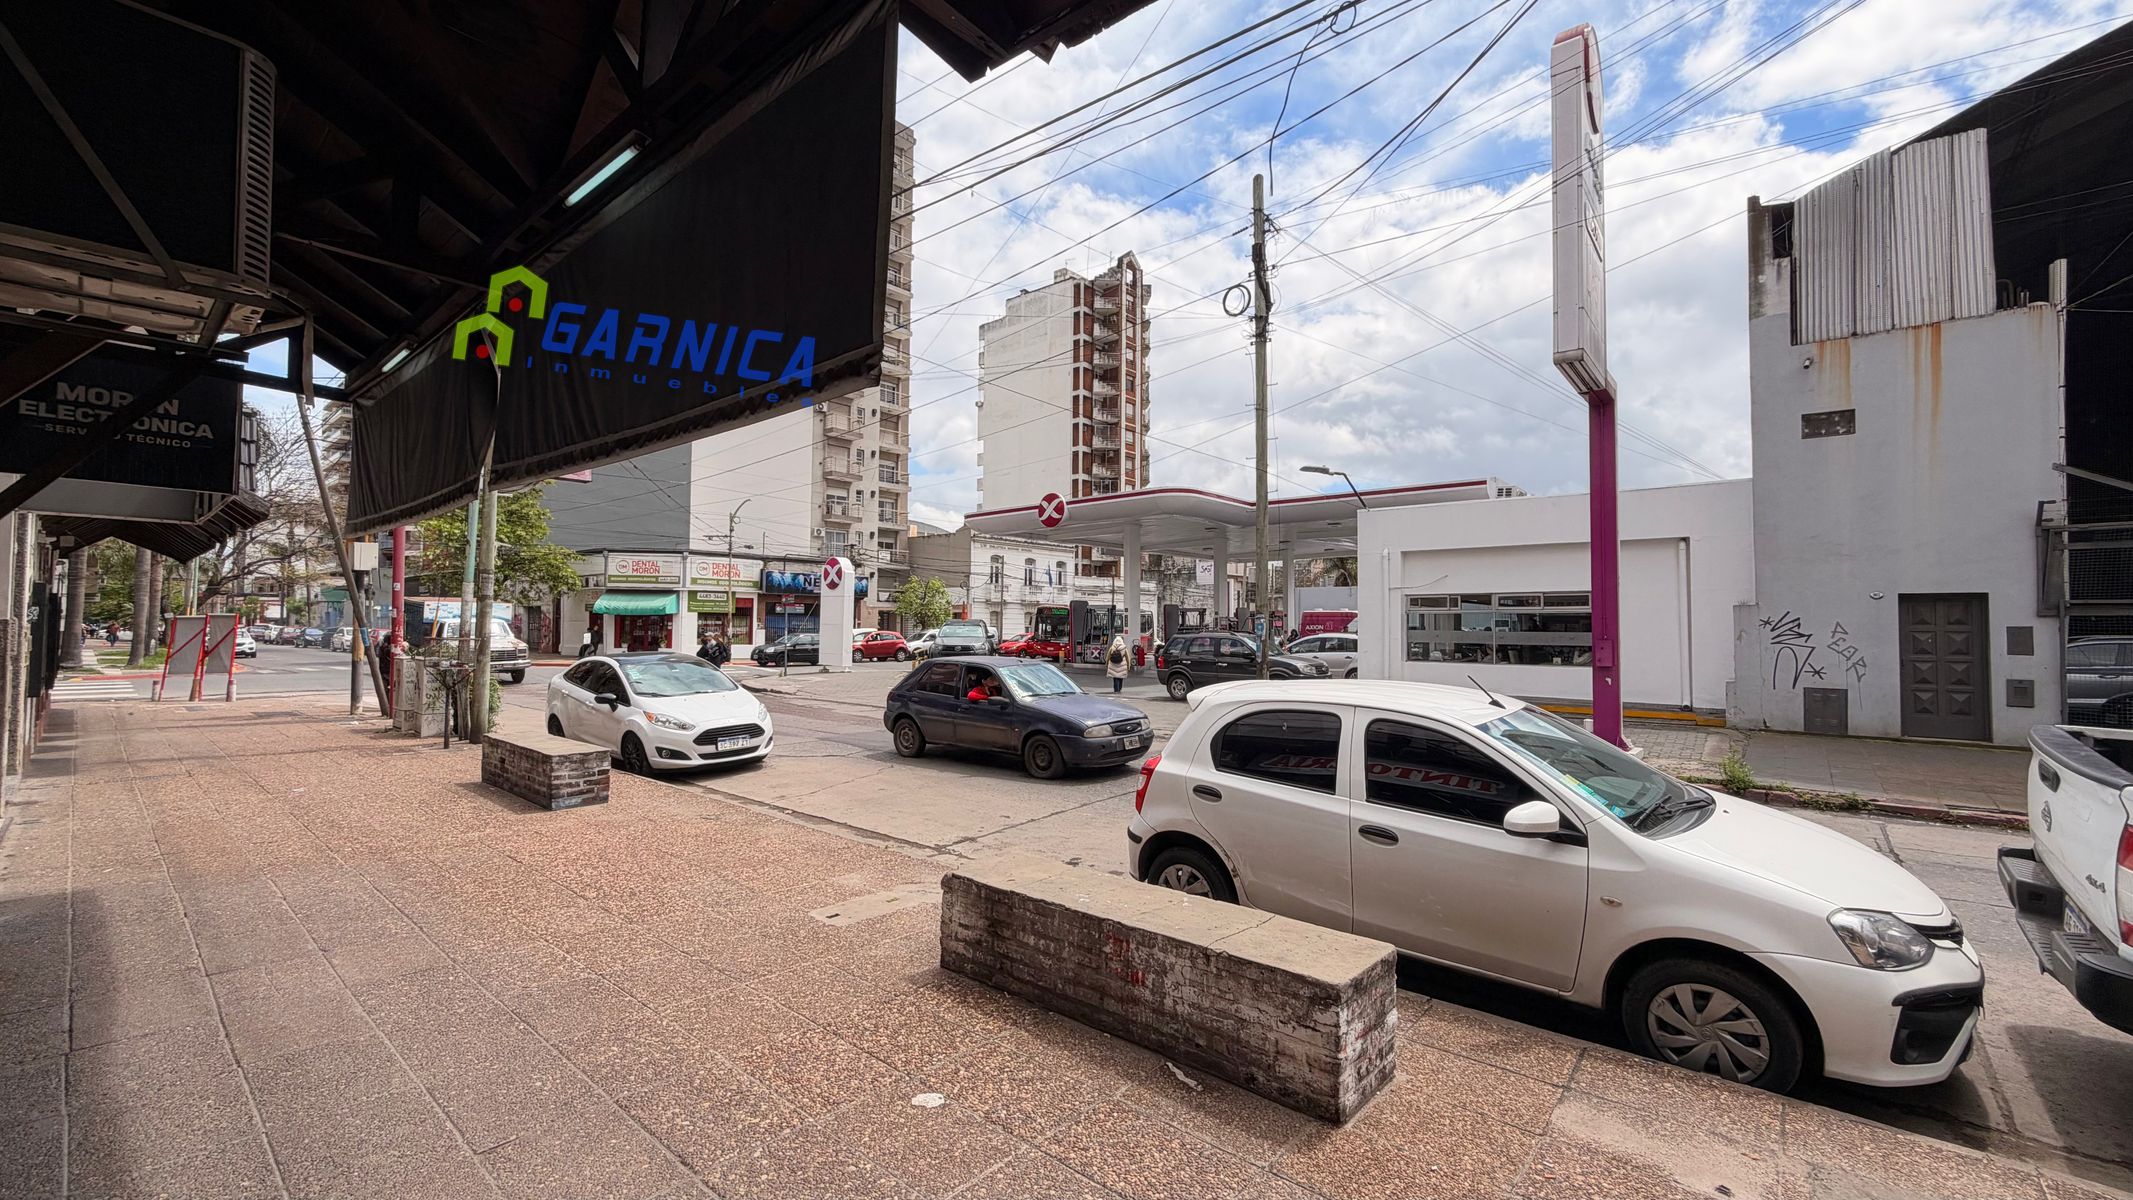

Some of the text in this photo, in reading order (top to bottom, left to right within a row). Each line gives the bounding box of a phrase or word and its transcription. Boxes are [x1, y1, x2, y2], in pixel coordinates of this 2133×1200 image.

[56, 381, 180, 416] MORN
[18, 398, 214, 439] ELECTONICA
[127, 432, 192, 449] TÉCNICO
[631, 567, 661, 575] MORON
